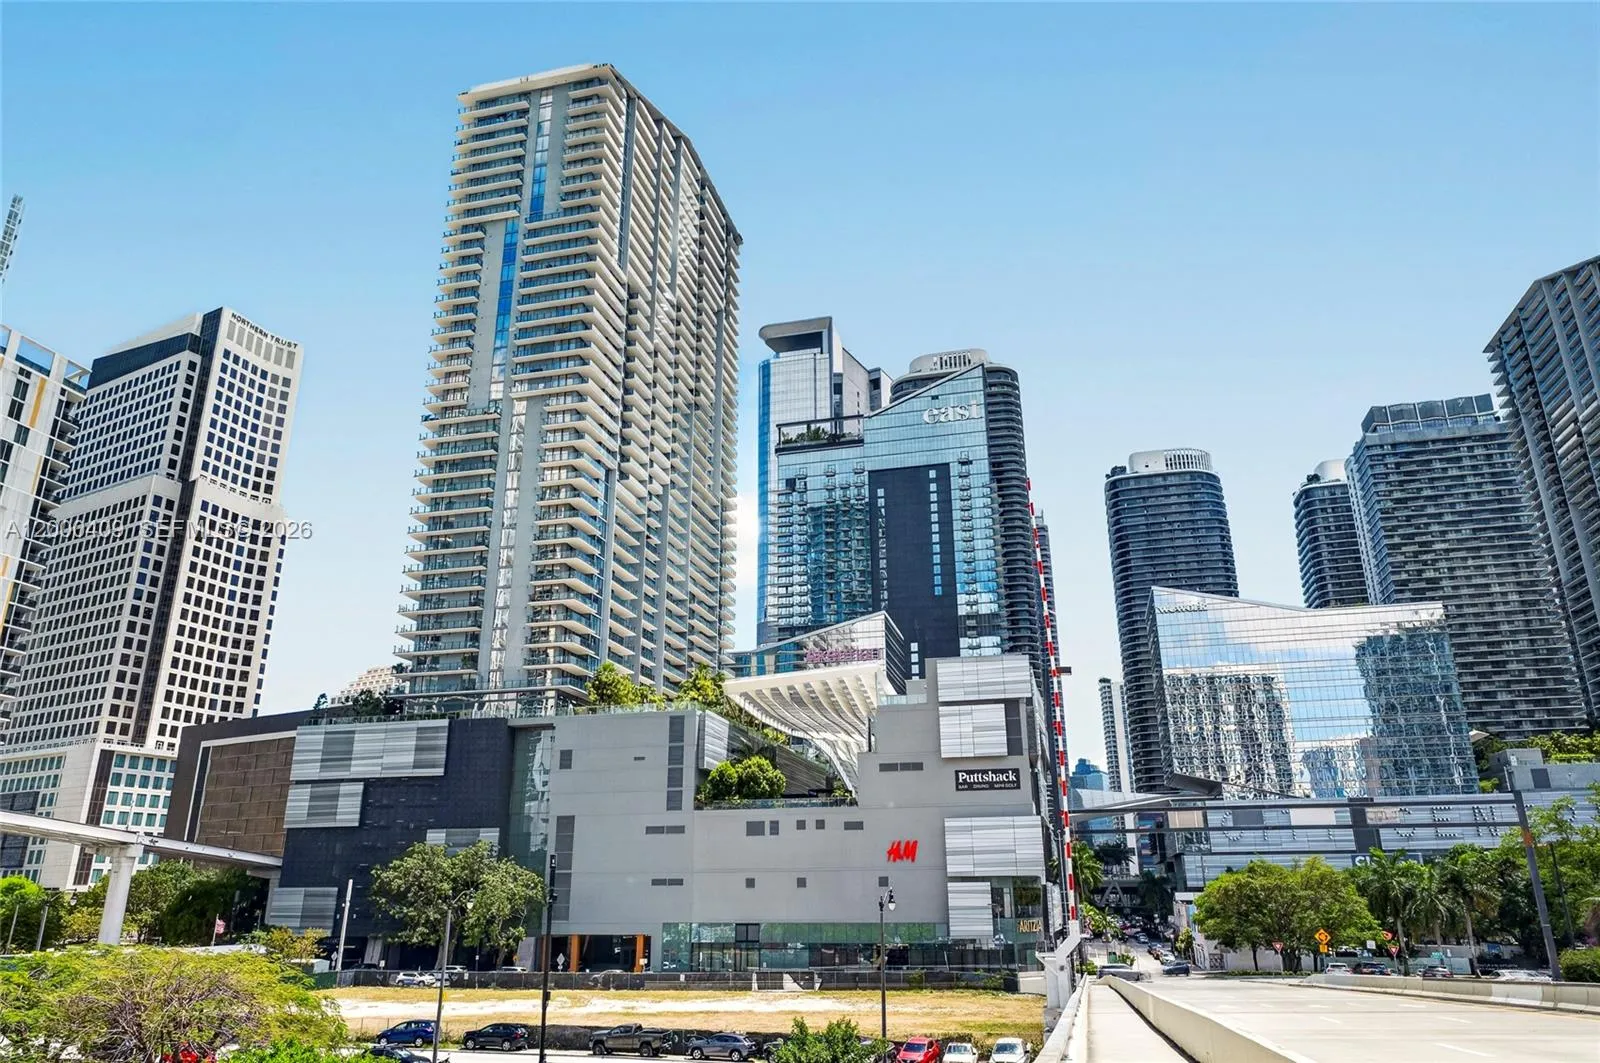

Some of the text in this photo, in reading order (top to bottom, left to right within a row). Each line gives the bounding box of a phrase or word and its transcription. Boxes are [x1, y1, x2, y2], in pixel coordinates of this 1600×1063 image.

[231, 312, 298, 349] NORTHERN TRUST
[958, 770, 1017, 783] Puttshack
[887, 840, 918, 862] H&M
